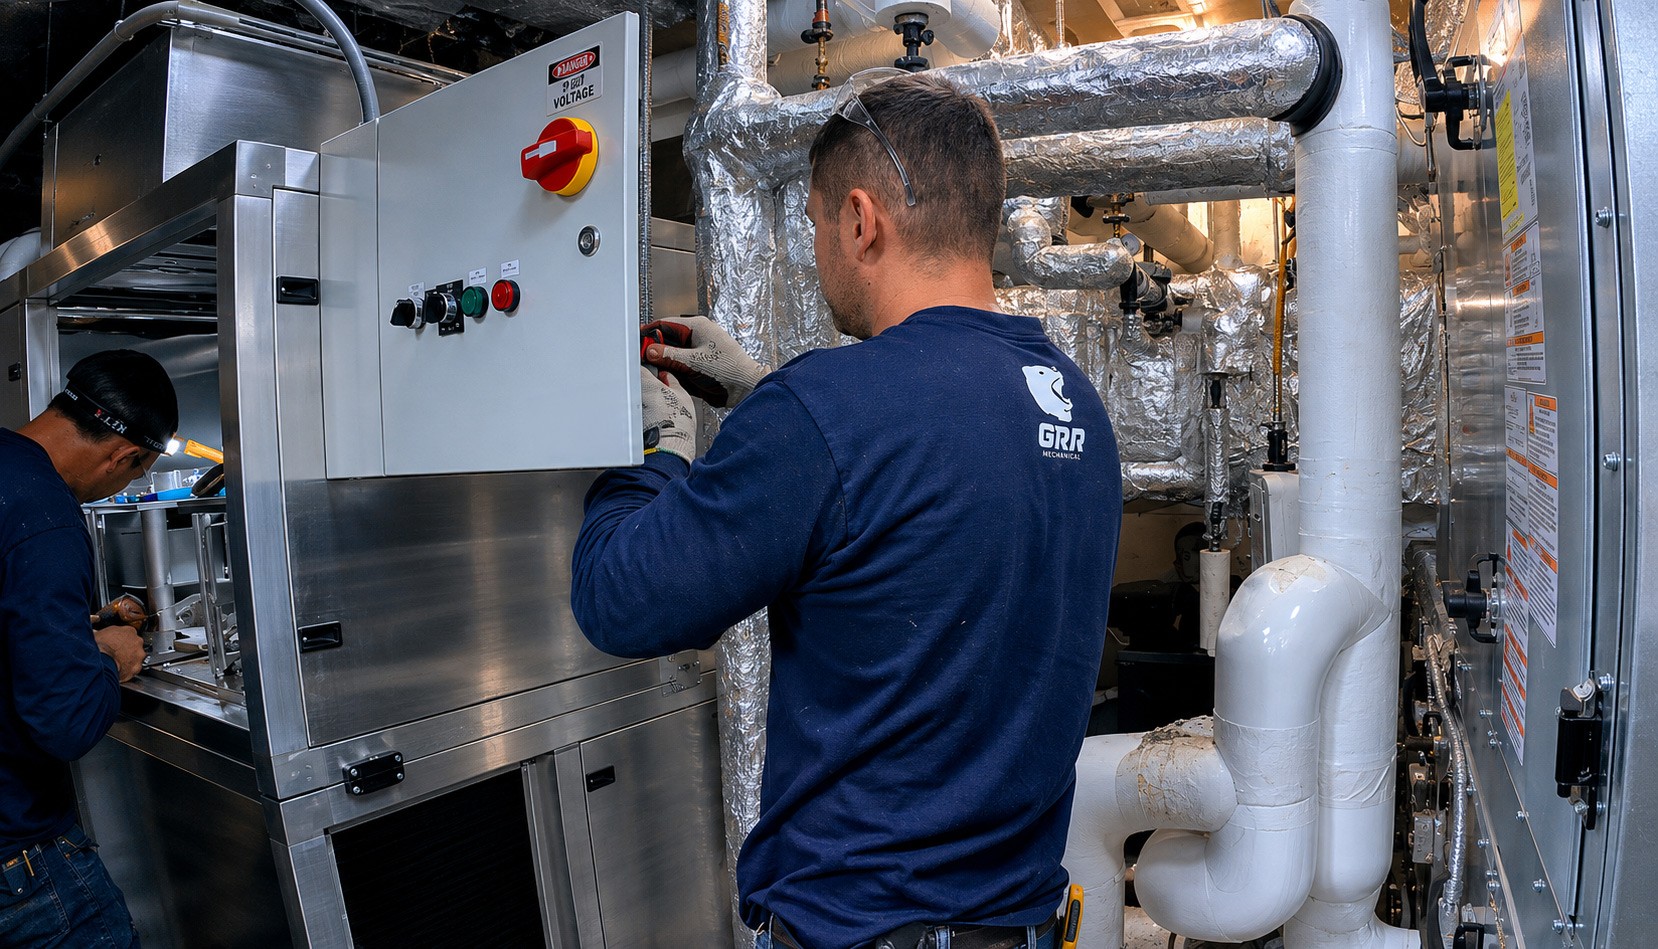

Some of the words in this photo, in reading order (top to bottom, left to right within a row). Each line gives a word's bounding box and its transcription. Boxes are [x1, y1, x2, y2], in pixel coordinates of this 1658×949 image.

[553, 84, 595, 109] VOLTAGE
[1038, 422, 1086, 452] GRR
[1042, 450, 1081, 460] MECHANICAL
